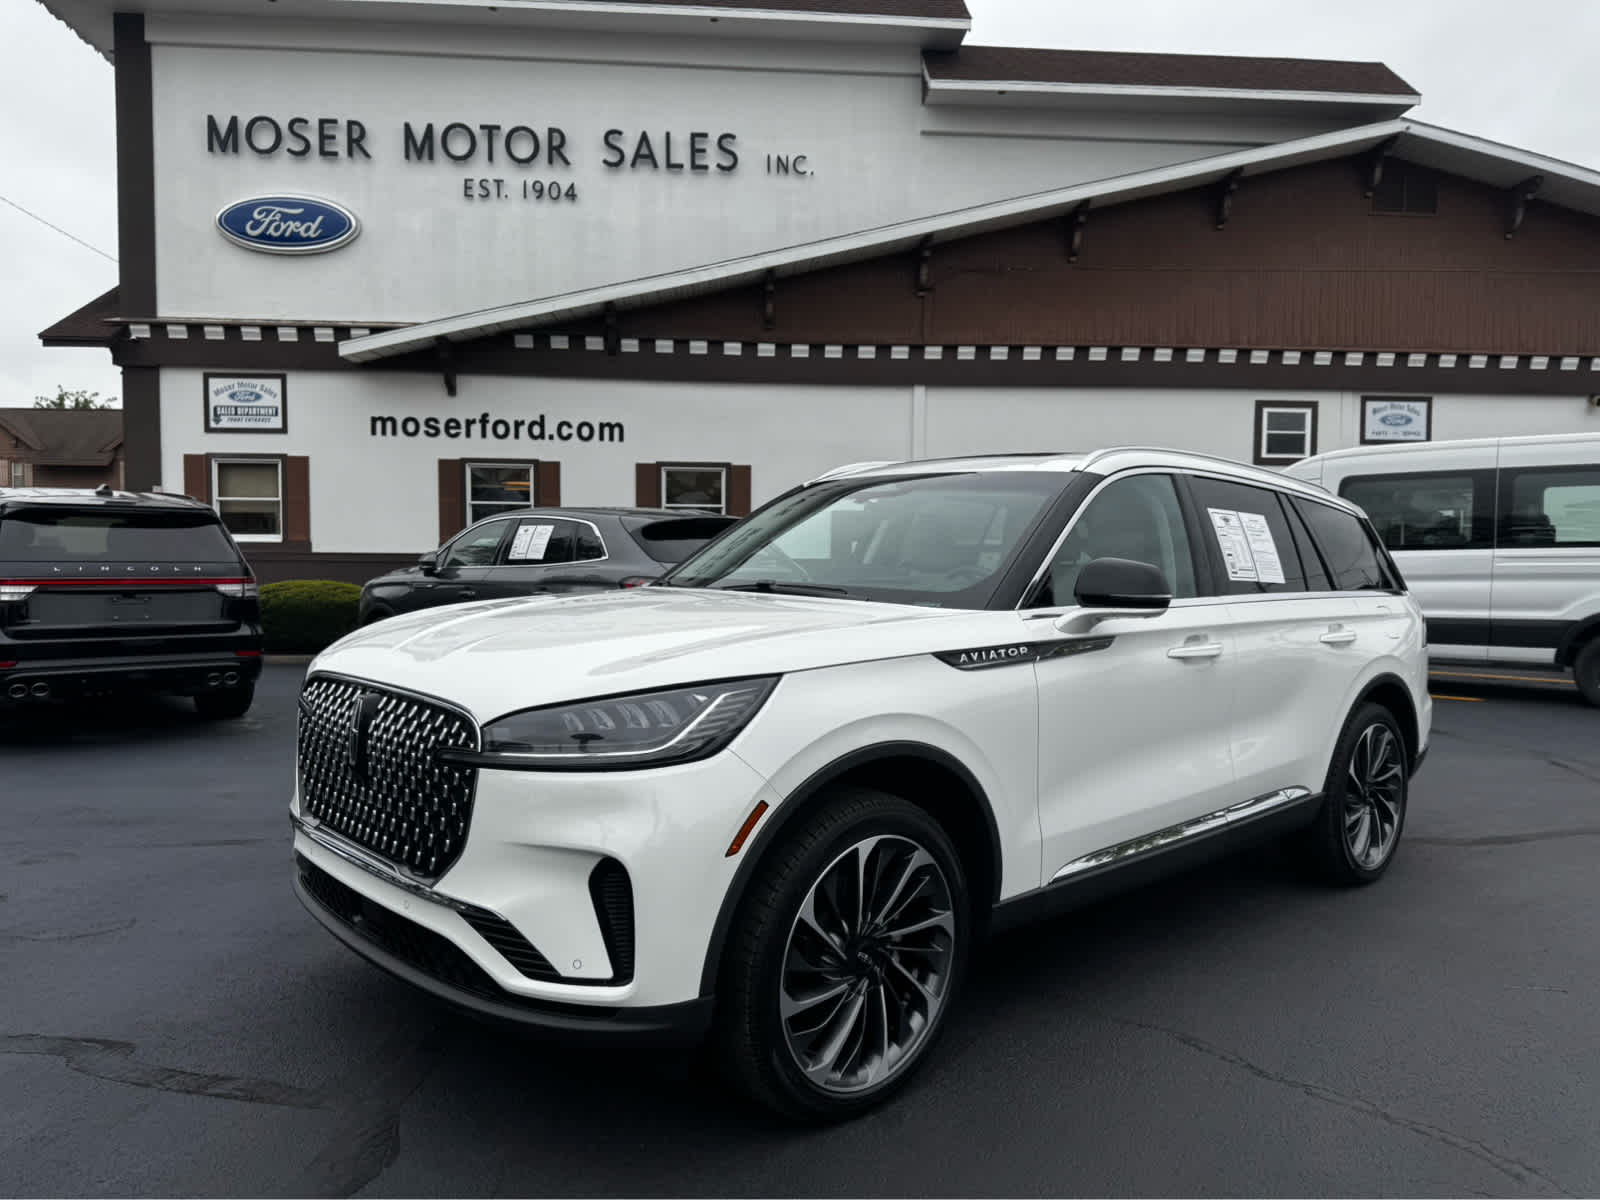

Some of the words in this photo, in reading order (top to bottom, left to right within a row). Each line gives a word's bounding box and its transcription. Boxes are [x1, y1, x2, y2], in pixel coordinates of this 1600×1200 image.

[206, 114, 371, 159] MOSER
[403, 122, 571, 166] MOTOR
[602, 129, 739, 172] SALES
[766, 153, 815, 176] INC.
[463, 178, 508, 199] EST.
[522, 180, 577, 201] 1904
[245, 205, 325, 238] Ford
[370, 412, 625, 442] moserford.com
[53, 565, 203, 573] LINCOLN
[959, 646, 1029, 664] AVIATOR
